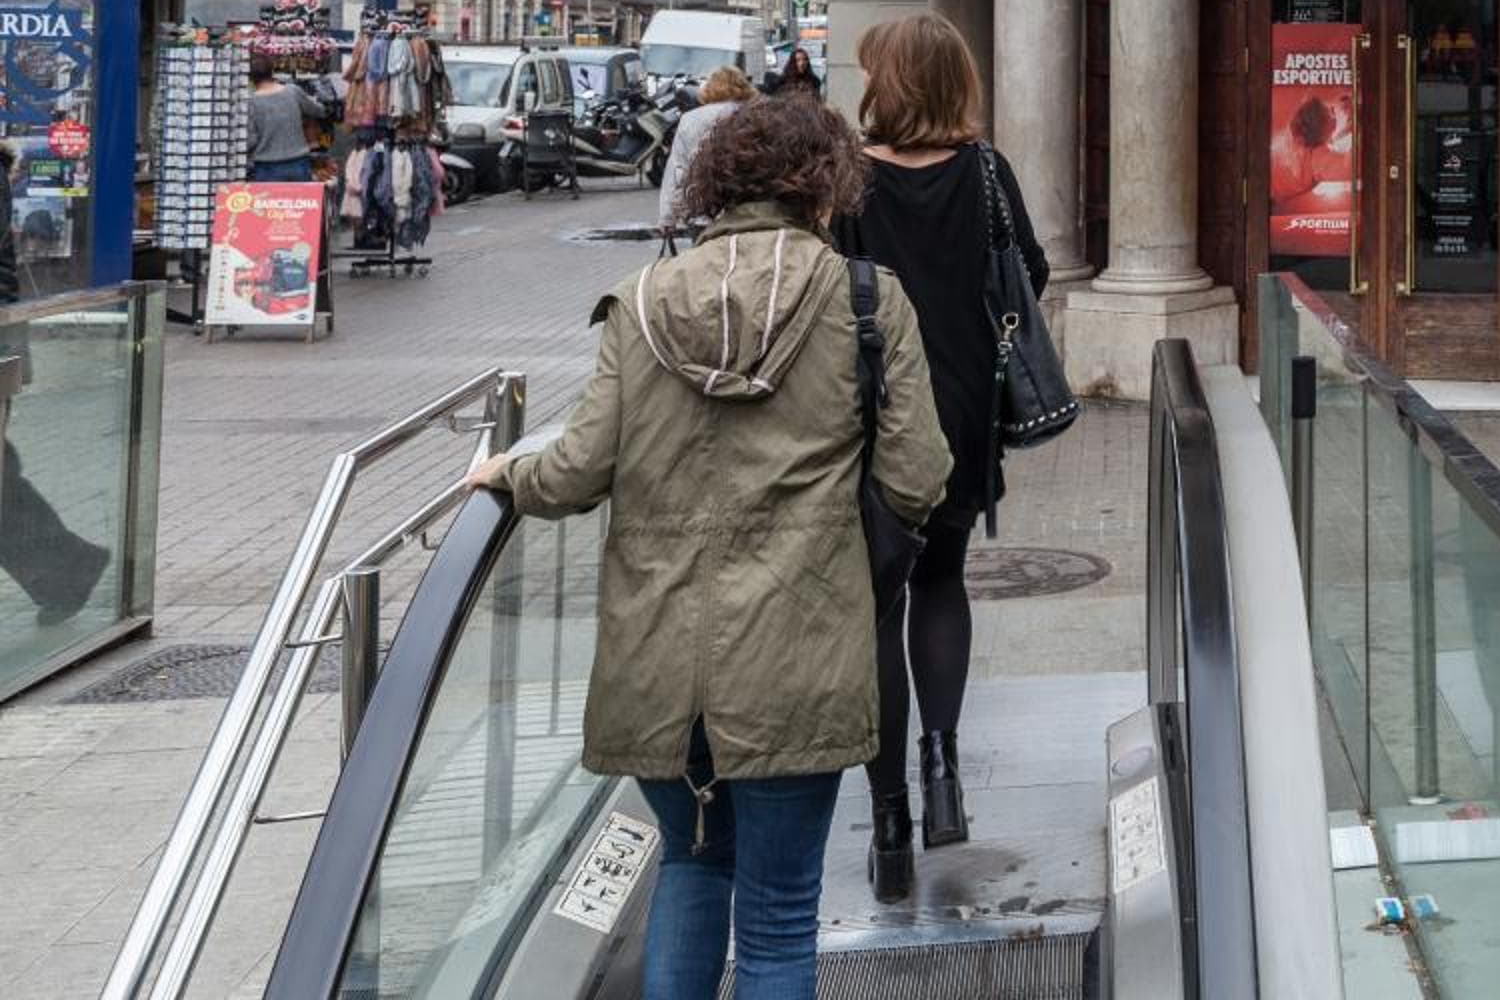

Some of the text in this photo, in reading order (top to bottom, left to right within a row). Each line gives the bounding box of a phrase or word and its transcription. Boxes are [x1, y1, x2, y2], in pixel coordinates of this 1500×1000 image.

[0, 12, 73, 37] RDIA
[1285, 54, 1348, 69] APOSTES
[1273, 70, 1360, 85] ESPORTIVE
[254, 199, 320, 209] BARCELONA
